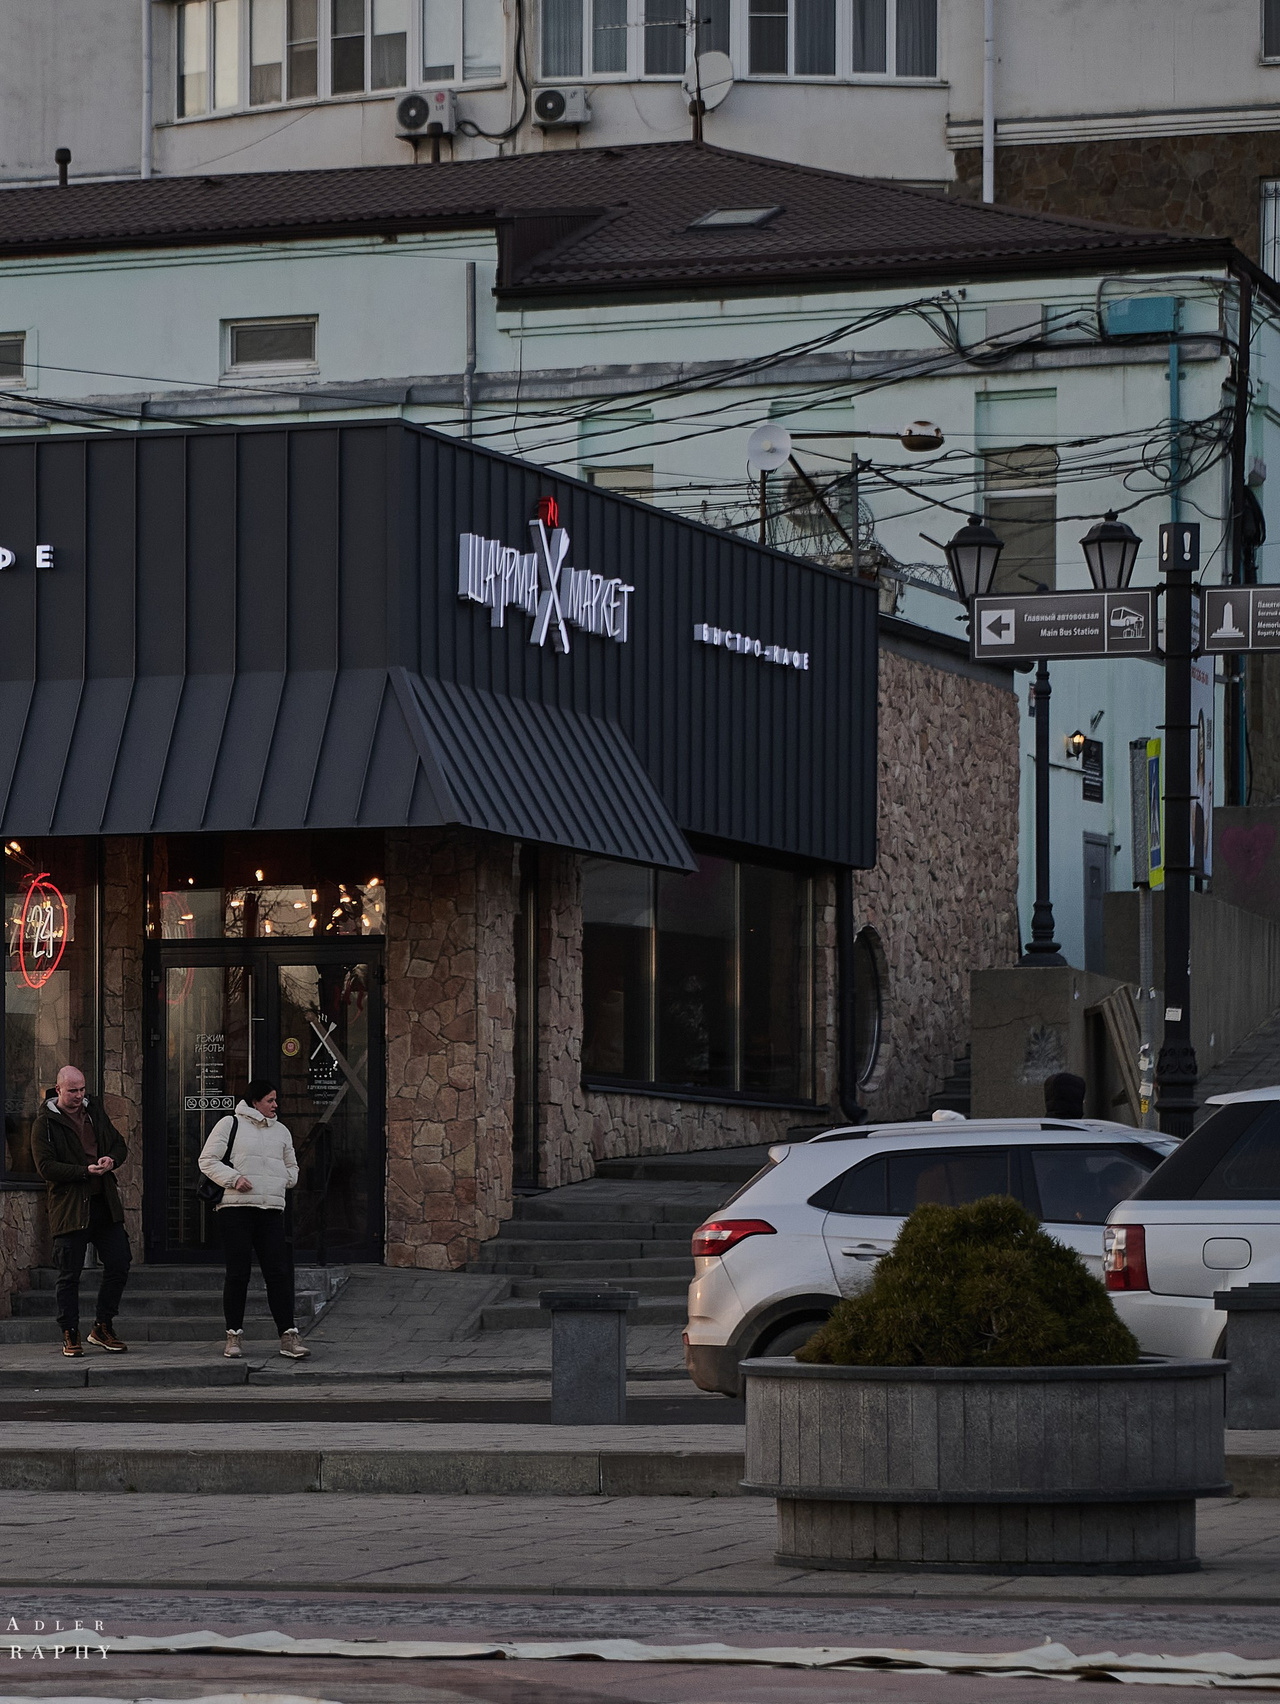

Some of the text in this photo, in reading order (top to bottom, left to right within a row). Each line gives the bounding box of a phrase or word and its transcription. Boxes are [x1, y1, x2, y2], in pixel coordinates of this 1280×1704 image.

[458, 532, 635, 643] ШАУРМА МАРКЕТ
[1023, 612, 1099, 622] Главный автовокзал
[1040, 627, 1099, 637] Main Bus Station
[27, 905, 54, 959] 24
[196, 1033, 225, 1043] РЕЖИМ
[194, 1043, 225, 1053] РАБОТЫ
